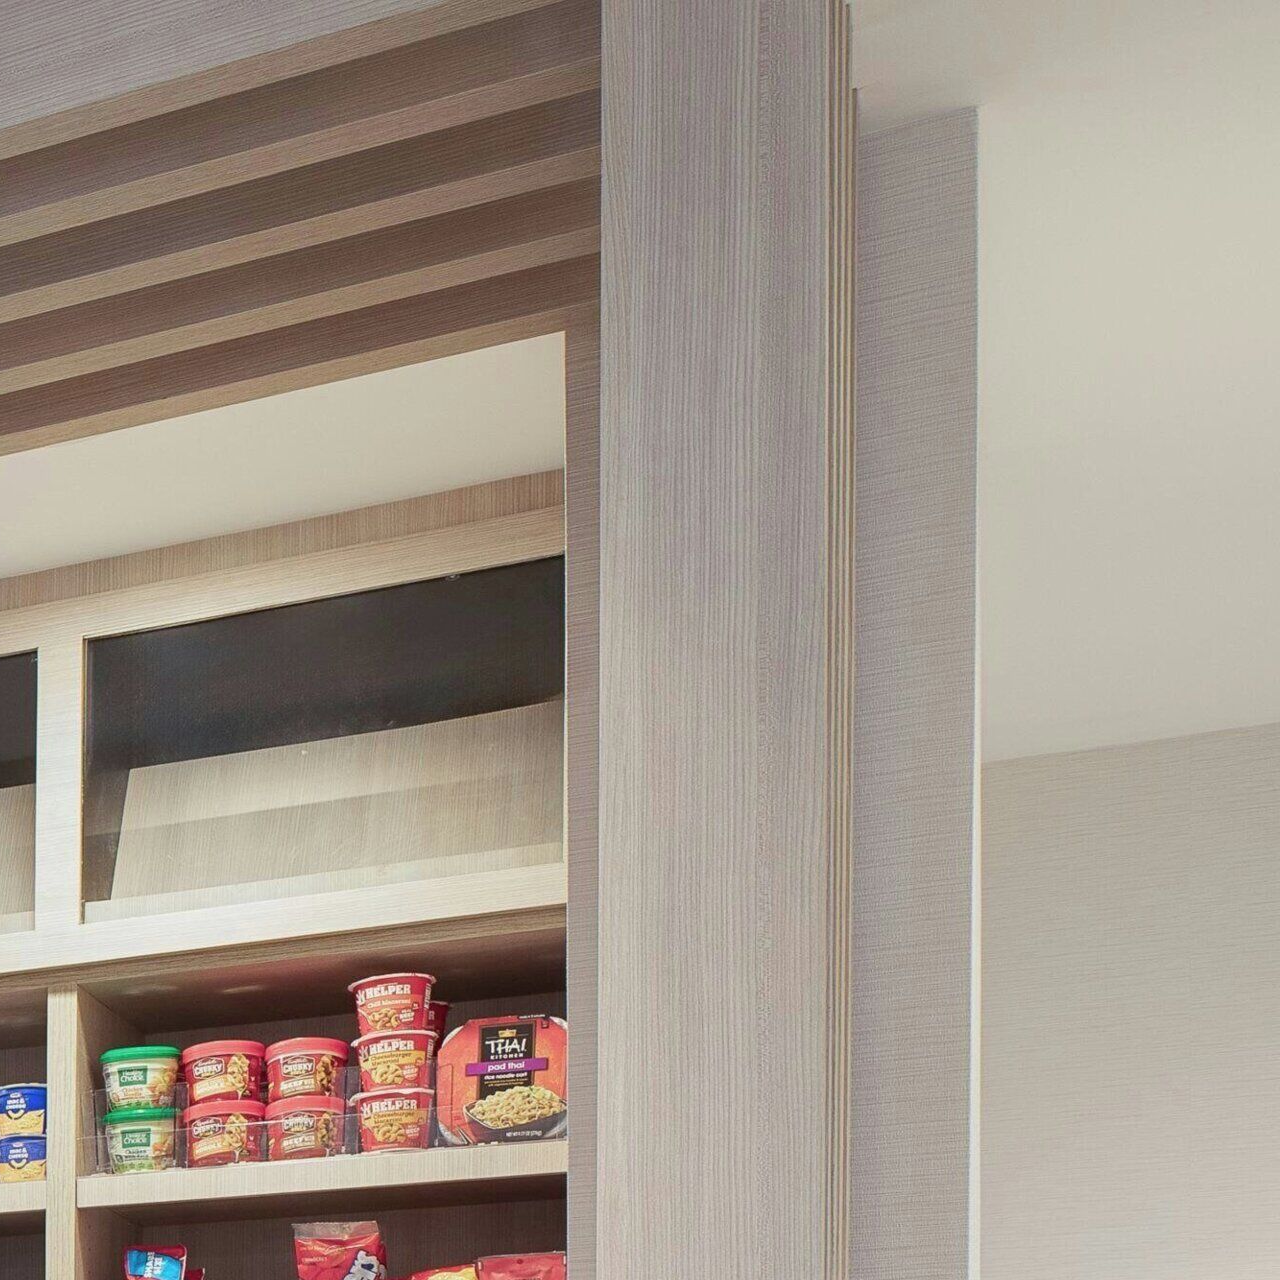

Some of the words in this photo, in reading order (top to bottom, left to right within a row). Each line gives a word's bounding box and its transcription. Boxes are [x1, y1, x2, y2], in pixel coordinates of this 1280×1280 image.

[365, 984, 411, 999] HELPER
[369, 1040, 414, 1055] HELPER
[485, 1038, 526, 1054] THAI
[488, 1062, 506, 1072] pad
[507, 1061, 525, 1070] thai
[371, 1100, 417, 1114] HELPER
